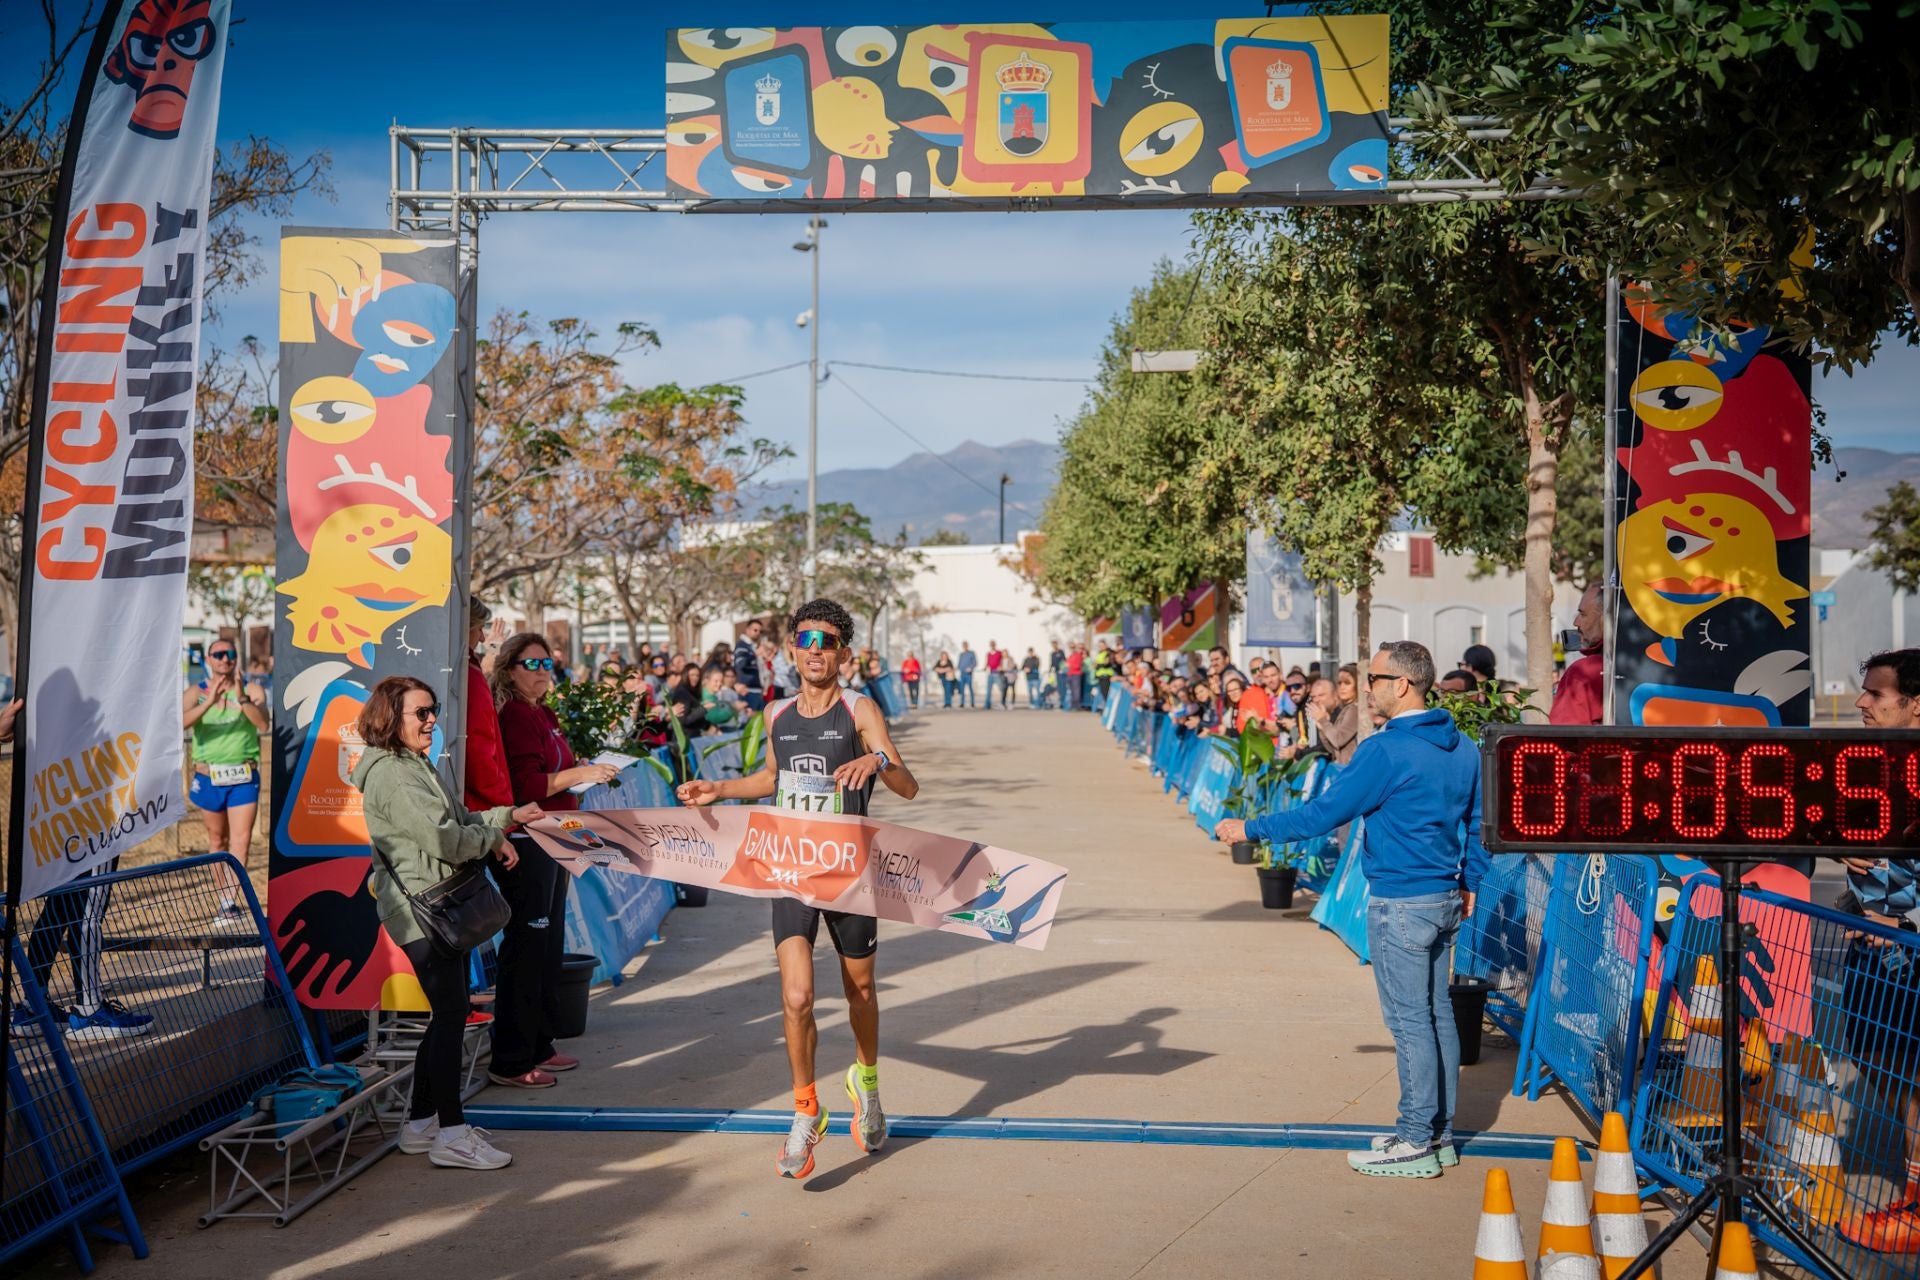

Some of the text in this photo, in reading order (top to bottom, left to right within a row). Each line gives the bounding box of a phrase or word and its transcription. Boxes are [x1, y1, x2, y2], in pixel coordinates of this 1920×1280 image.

[36, 202, 147, 581] CYCLING
[101, 201, 198, 580] MONKEY
[787, 793, 829, 812] 117
[648, 824, 706, 844] MEDIA
[688, 855, 729, 871] ROQUETAS
[744, 827, 858, 873] GANADOR
[879, 849, 920, 880] MEDIA
